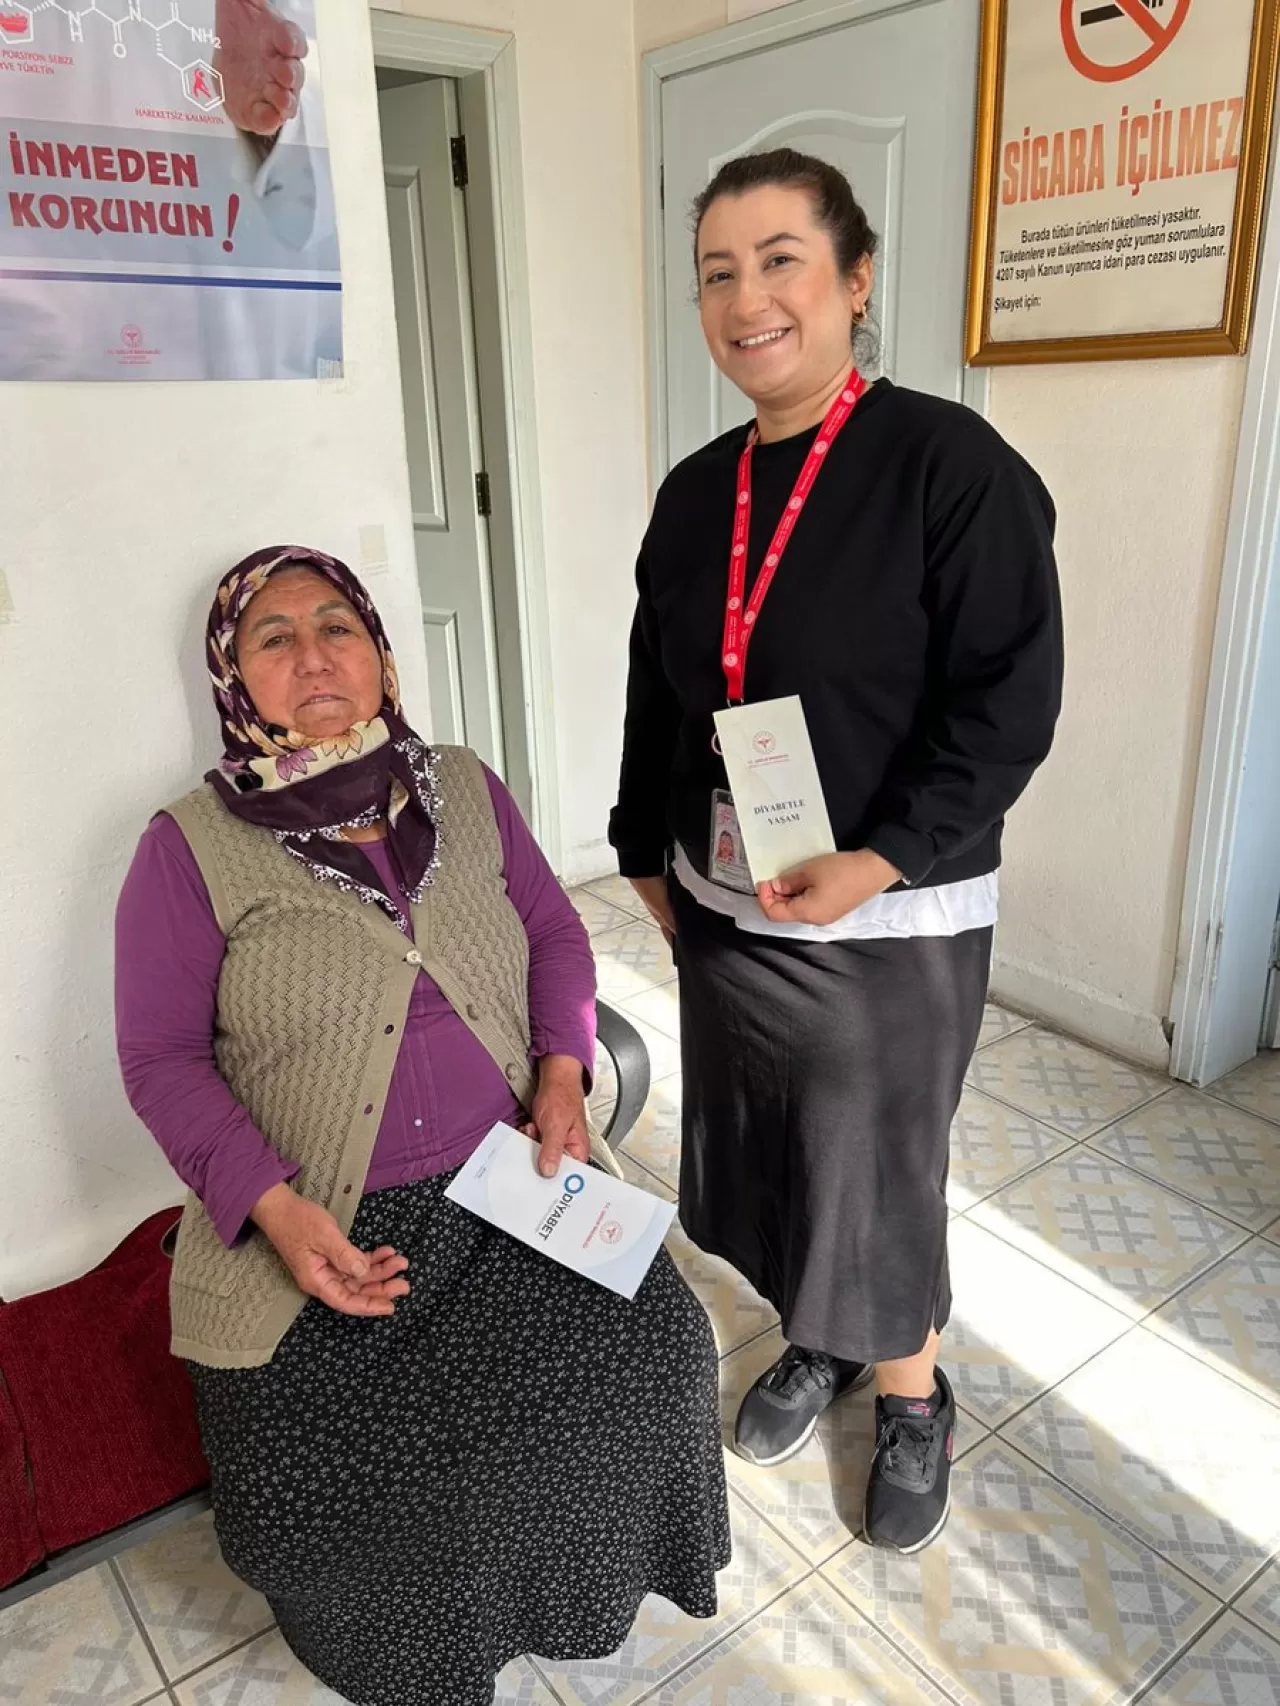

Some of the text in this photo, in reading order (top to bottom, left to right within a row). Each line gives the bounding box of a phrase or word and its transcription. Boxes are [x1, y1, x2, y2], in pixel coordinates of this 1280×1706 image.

[9, 131, 199, 188] İNMEDEN
[1001, 96, 1244, 206] SİGARA İÇİLMEZ
[9, 191, 214, 238] KORUNUN
[1021, 205, 1201, 244] Burada tütün ürünleri tüketilmesi yasaktır.
[996, 242, 1227, 282] 4207 sayılı Kanun uyarınca idari para cezası uygulanır.
[1000, 222, 1226, 264] Tüketenlere ve tüketilmesine göz yuman sorumlulara
[994, 296, 1023, 313] Şikayet
[754, 798, 806, 815] DİYABETLE
[767, 813, 800, 825] YAŞAM
[538, 1192, 574, 1241] DİYABET
